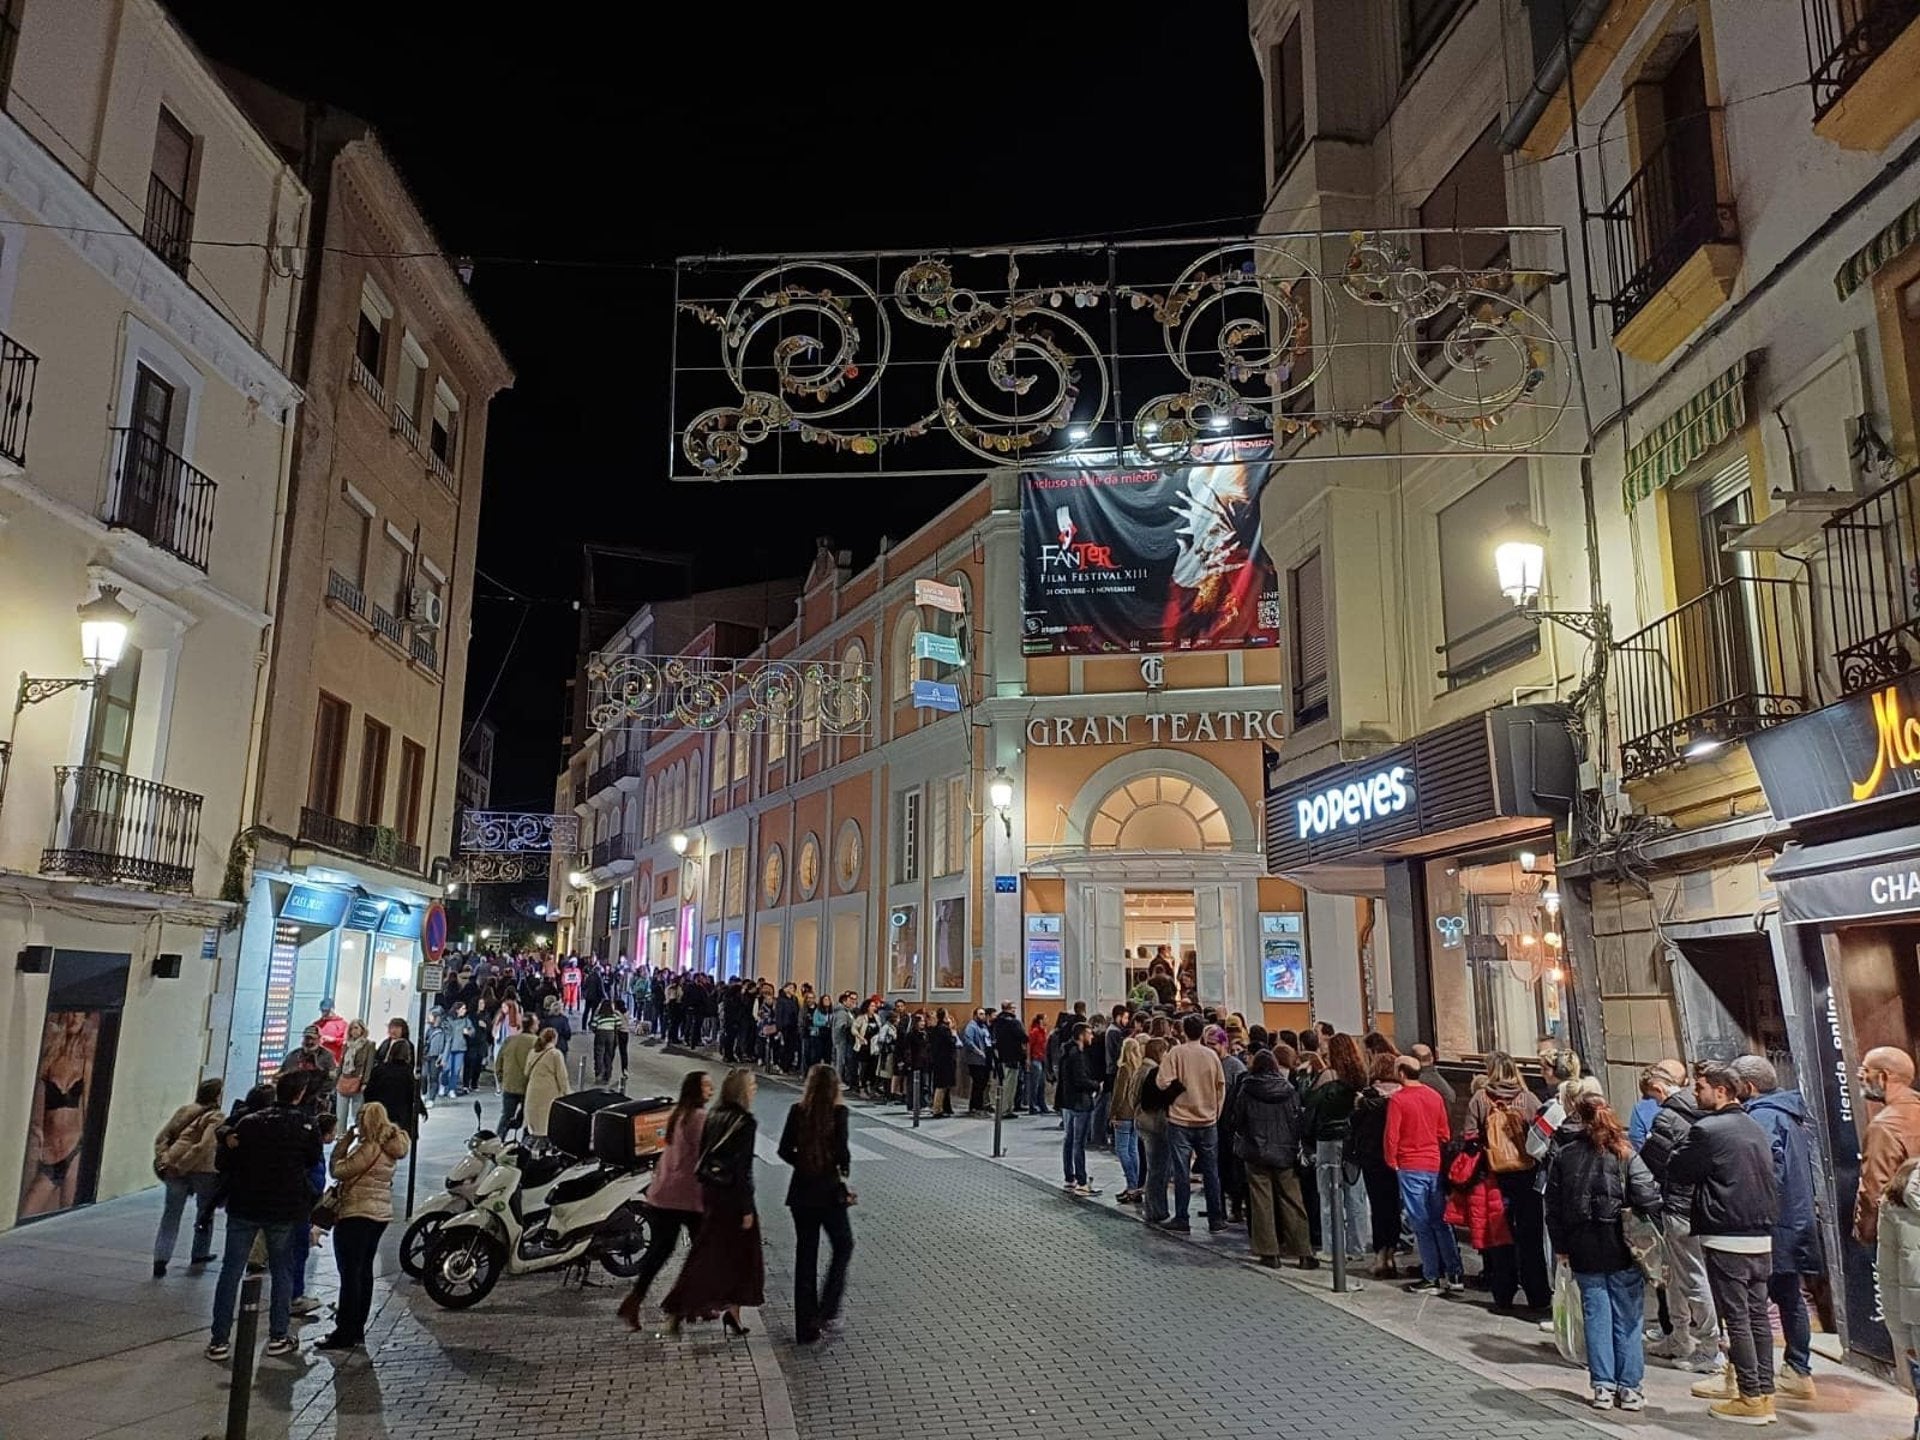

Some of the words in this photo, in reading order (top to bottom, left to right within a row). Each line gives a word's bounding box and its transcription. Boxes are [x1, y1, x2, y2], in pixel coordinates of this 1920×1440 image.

[1070, 479, 1077, 487] a
[1121, 470, 1158, 483] miedo
[1041, 573, 1066, 584] FILM
[1072, 570, 1122, 582] FESTIVAL
[1125, 567, 1149, 578] XIII
[1026, 715, 1130, 746] GRAN
[1145, 710, 1285, 743] TEATRO
[1835, 1060, 1853, 1123] tienda
